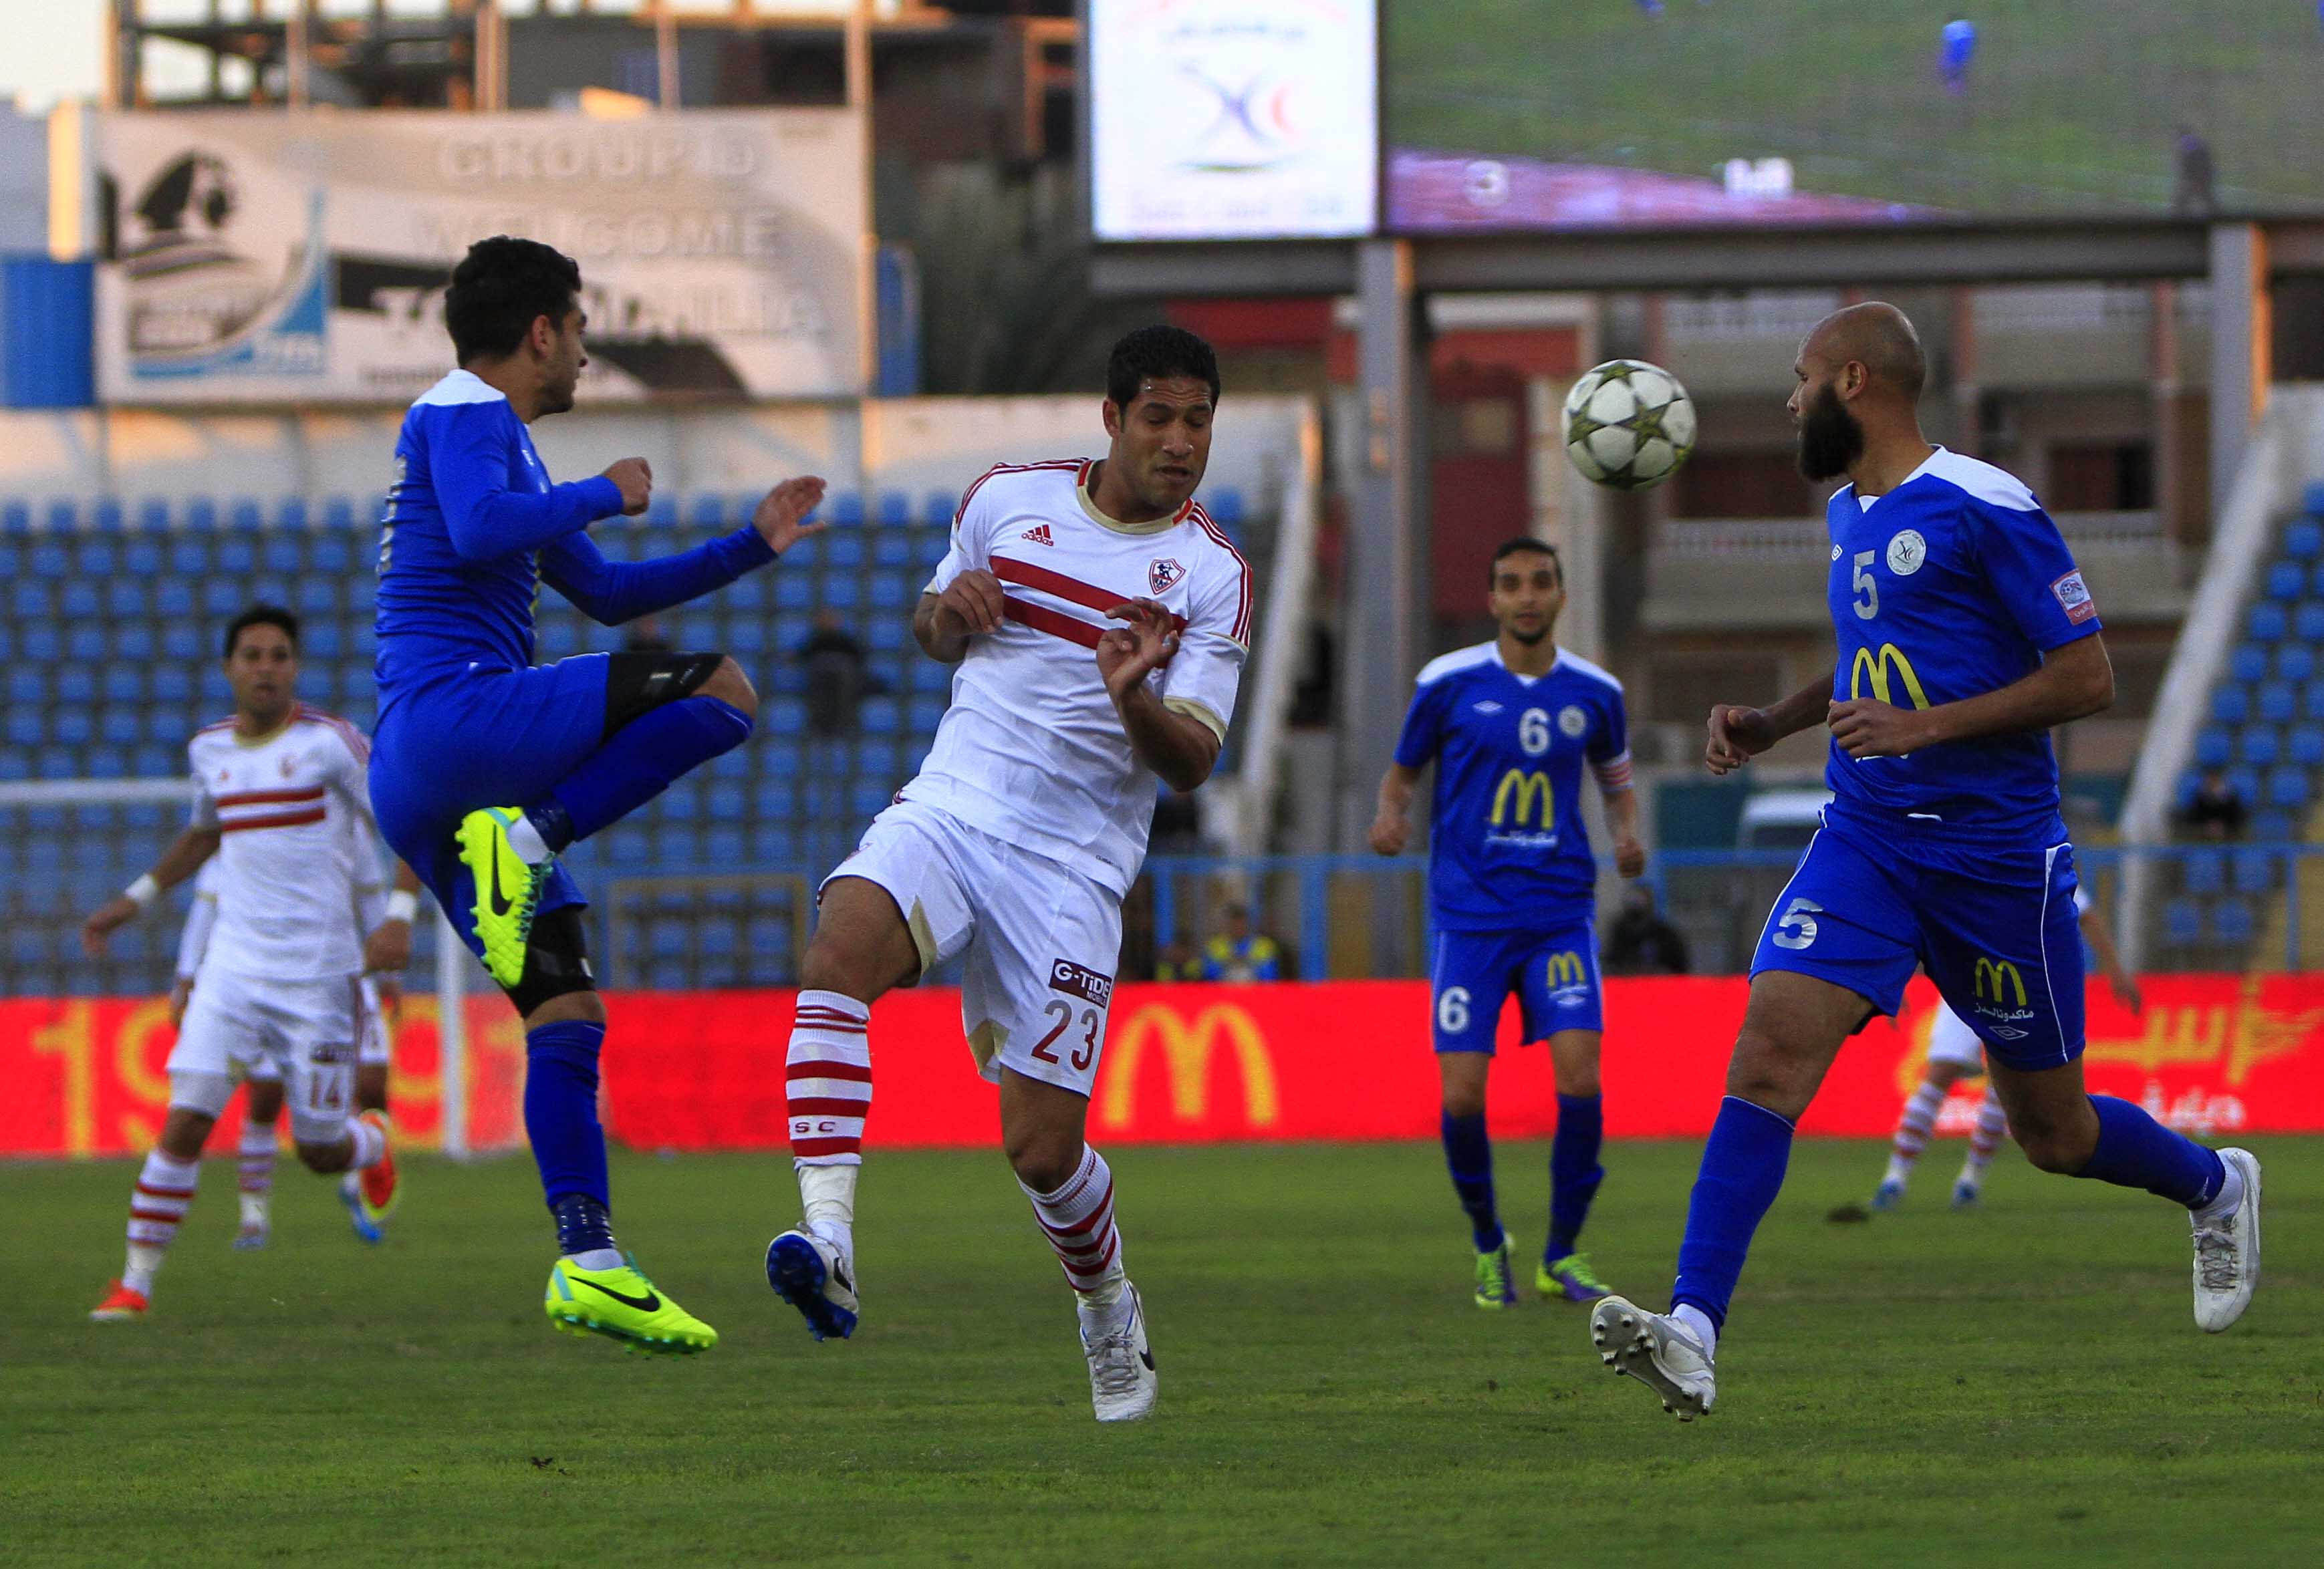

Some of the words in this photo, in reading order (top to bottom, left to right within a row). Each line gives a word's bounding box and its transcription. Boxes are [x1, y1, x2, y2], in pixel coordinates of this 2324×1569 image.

[440, 137, 683, 179] GROUP
[1022, 533, 1054, 547] adidas
[1853, 549, 1879, 620] 5
[1519, 707, 1551, 755] 6
[1773, 897, 1825, 950] 5
[1438, 986, 1470, 1034] 6
[1031, 999, 1098, 1071] 23
[310, 1071, 342, 1110] 14
